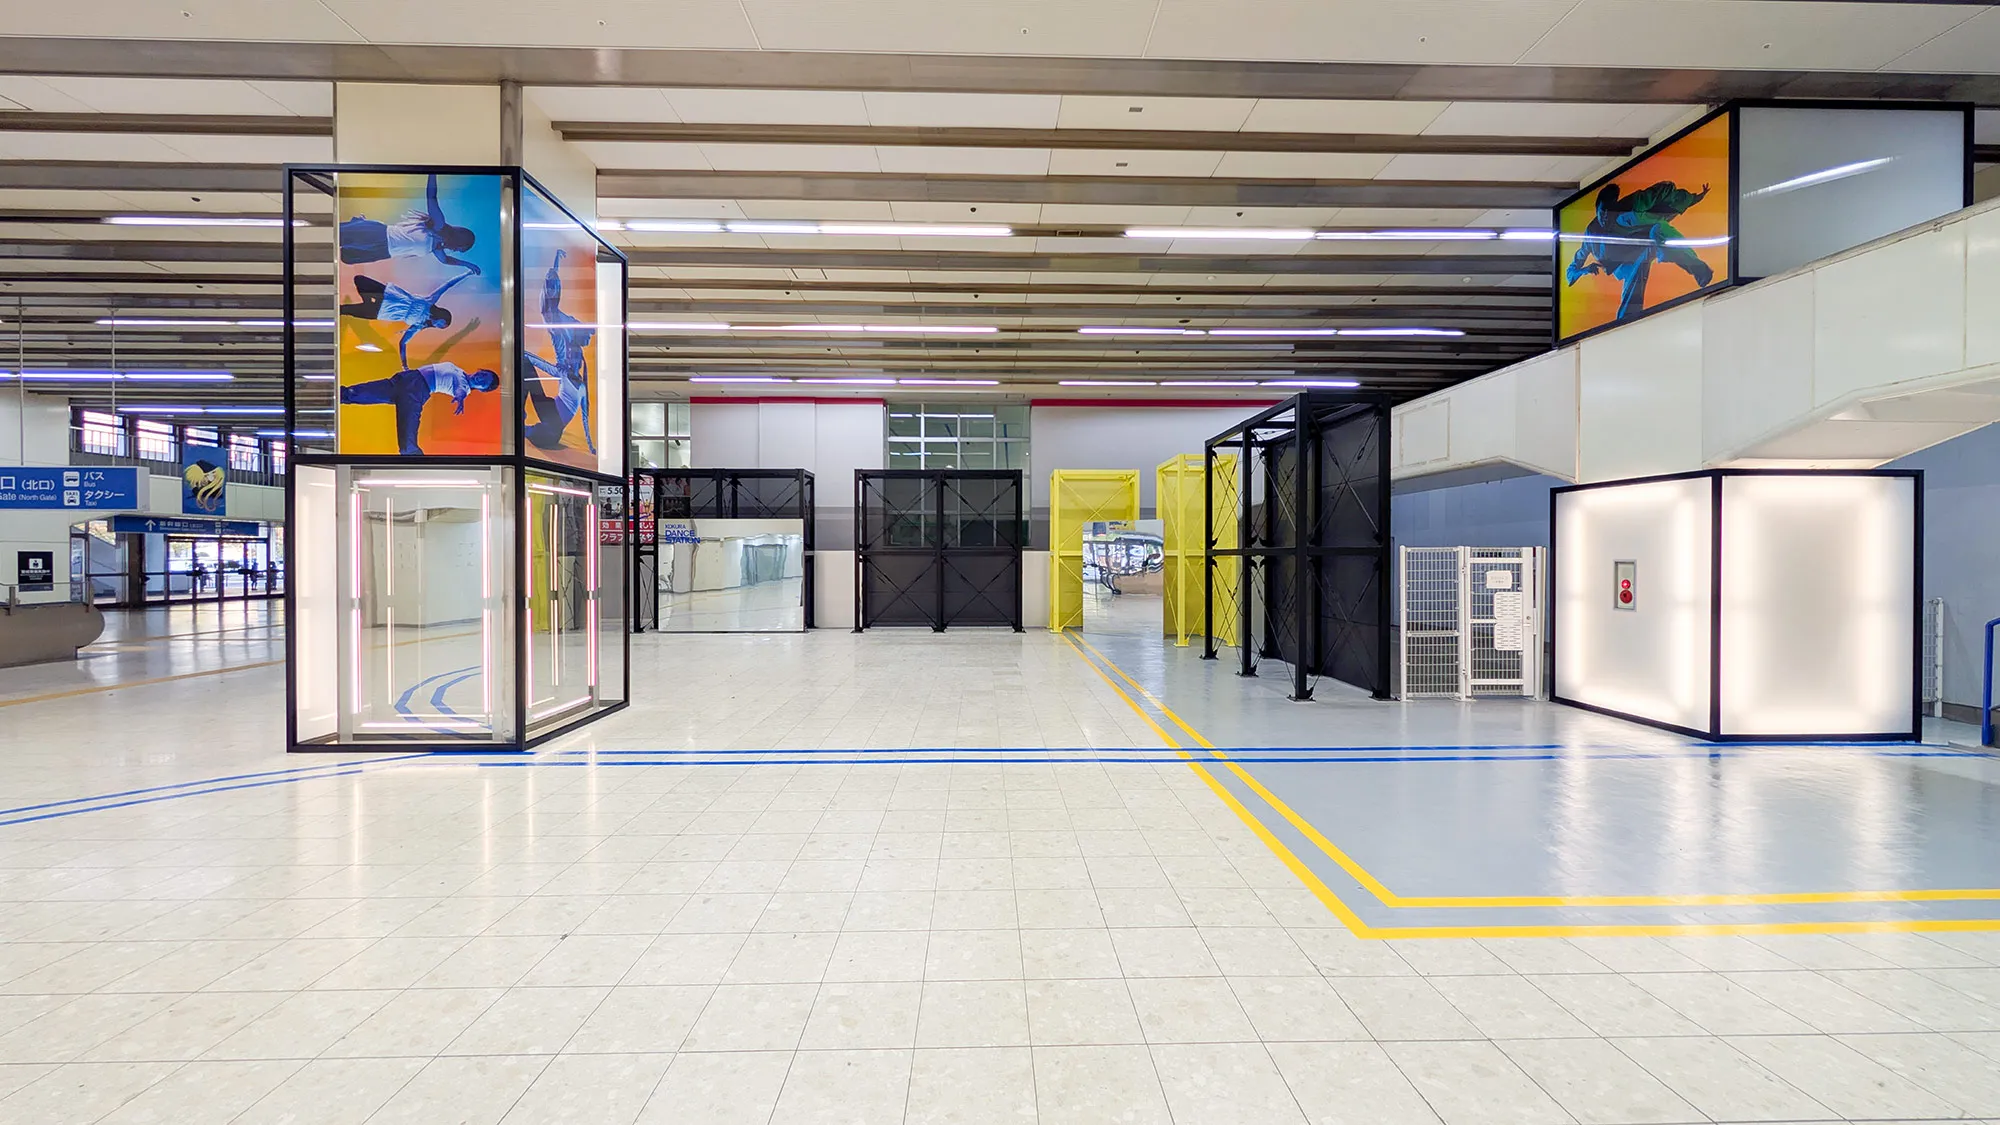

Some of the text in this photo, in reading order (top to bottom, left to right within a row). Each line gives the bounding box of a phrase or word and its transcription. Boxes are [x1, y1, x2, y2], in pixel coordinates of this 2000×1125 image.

[84, 471, 105, 480] バス
[84, 490, 125, 500] タクシー
[665, 536, 701, 544] STATION
